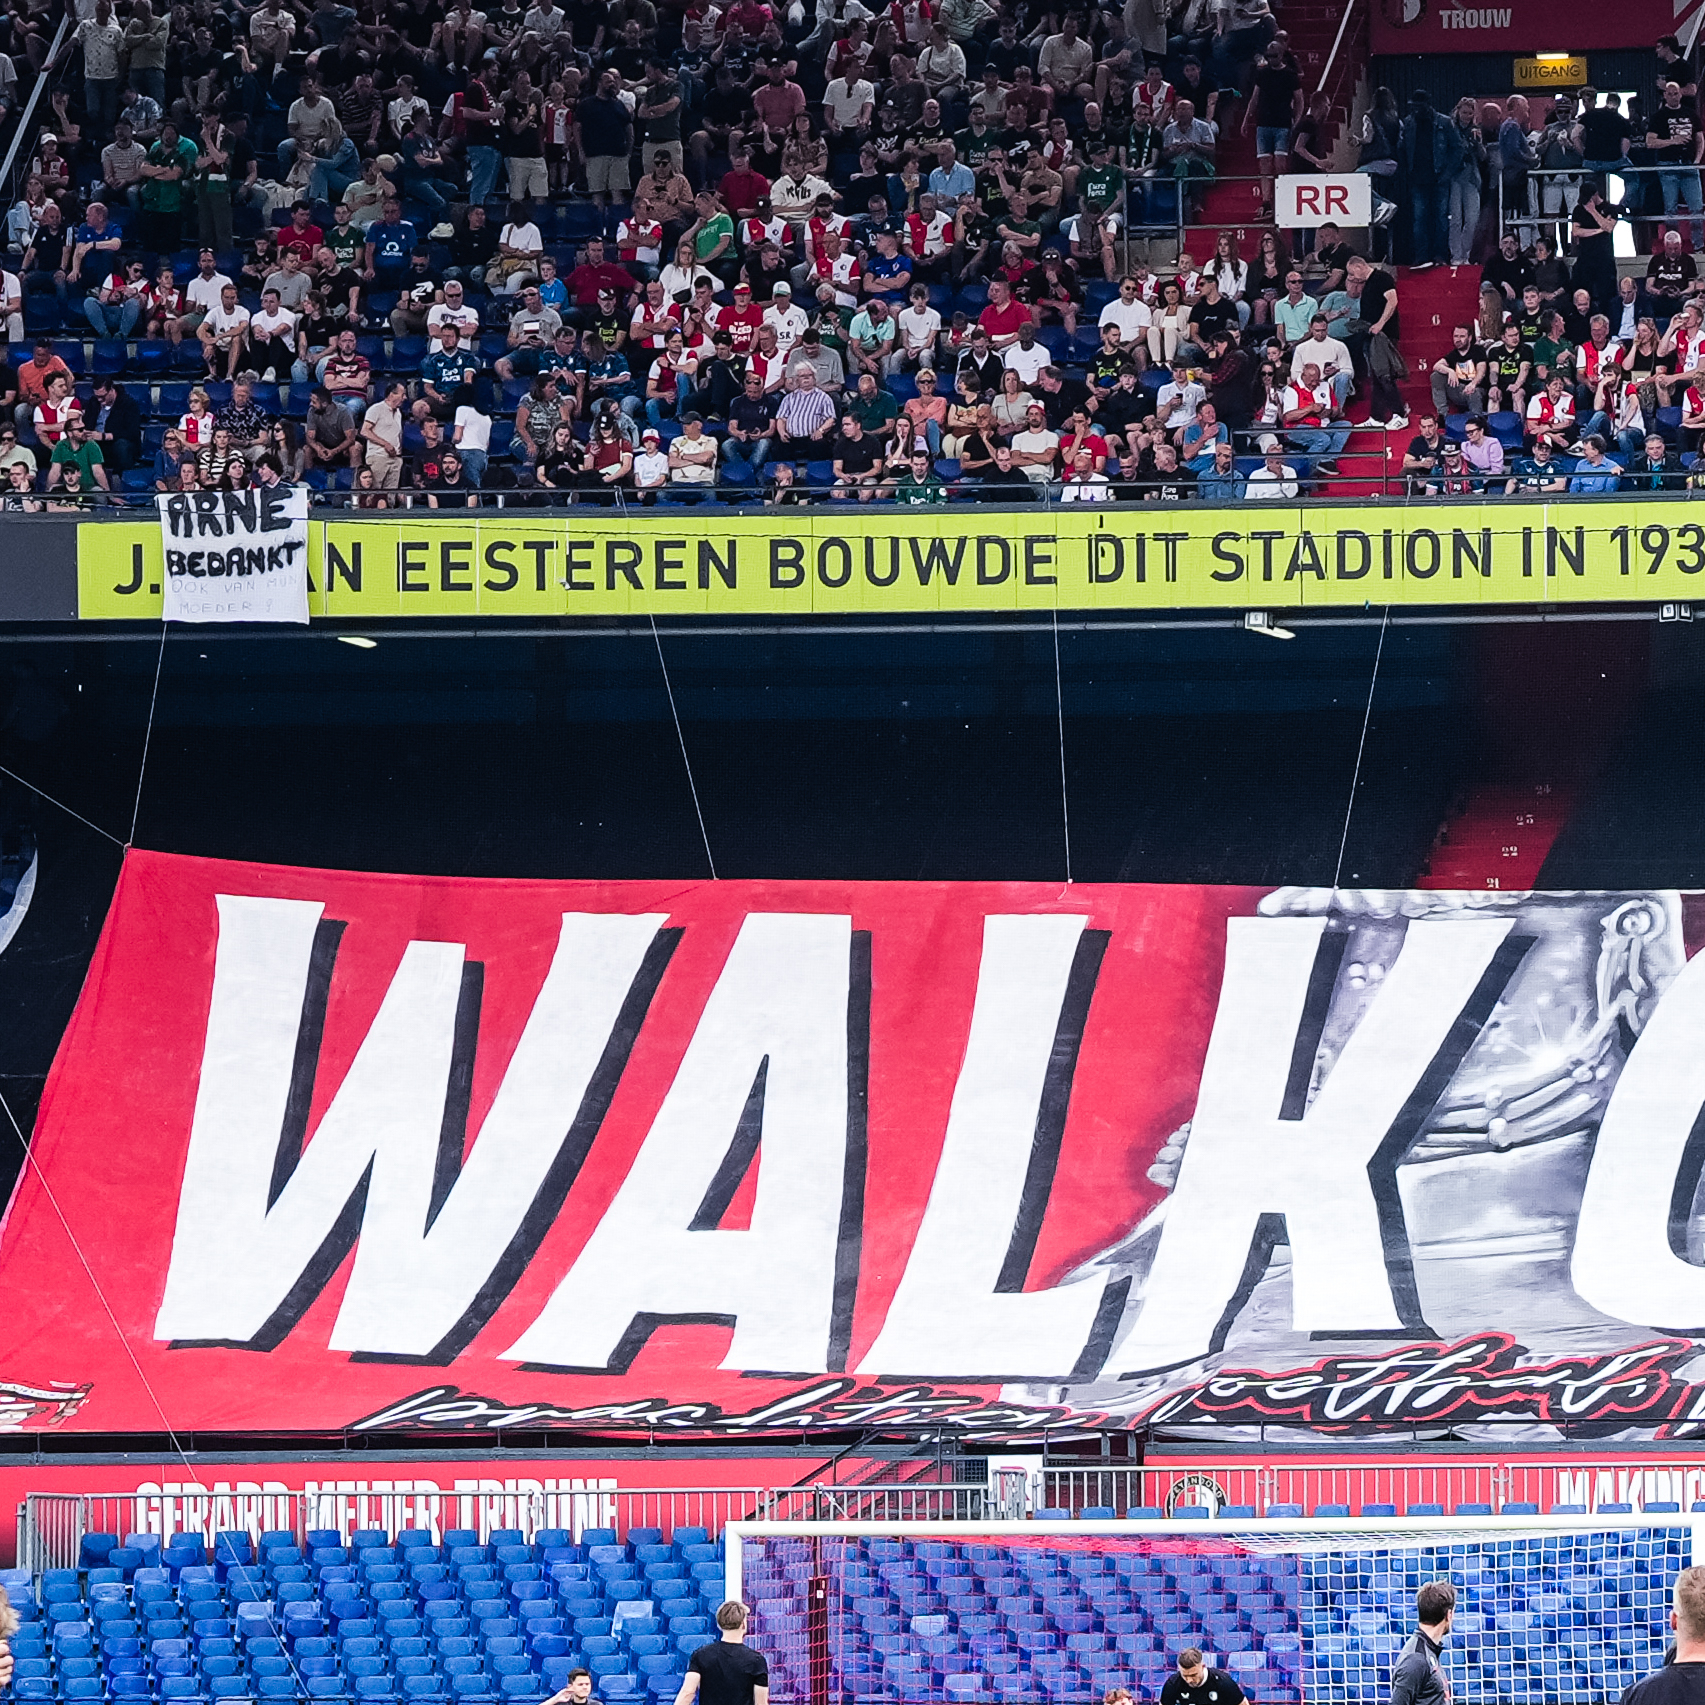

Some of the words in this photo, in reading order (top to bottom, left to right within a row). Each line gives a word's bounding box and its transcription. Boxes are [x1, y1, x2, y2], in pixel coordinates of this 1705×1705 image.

[1439, 9, 1512, 29] TROUW
[1519, 64, 1581, 79] UITGANG
[1295, 185, 1350, 216] RR
[1449, 266, 1457, 278] 7
[1431, 314, 1440, 325] 6
[1417, 358, 1427, 371] 5
[168, 487, 293, 538] ARNE
[166, 540, 305, 578] BEDANKT
[397, 539, 736, 593] EESTEREN
[770, 536, 1059, 589] BOUWDE
[1088, 532, 1189, 585] DIT
[1210, 527, 1492, 582] STADION
[1522, 525, 1585, 577] IN
[171, 579, 208, 595] OOK
[224, 579, 256, 594] VAN
[180, 601, 252, 614] MOEDER
[153, 893, 1518, 1379] WALK
[137, 1479, 290, 1549] GERARD
[454, 1478, 619, 1547] TRIBUNE
